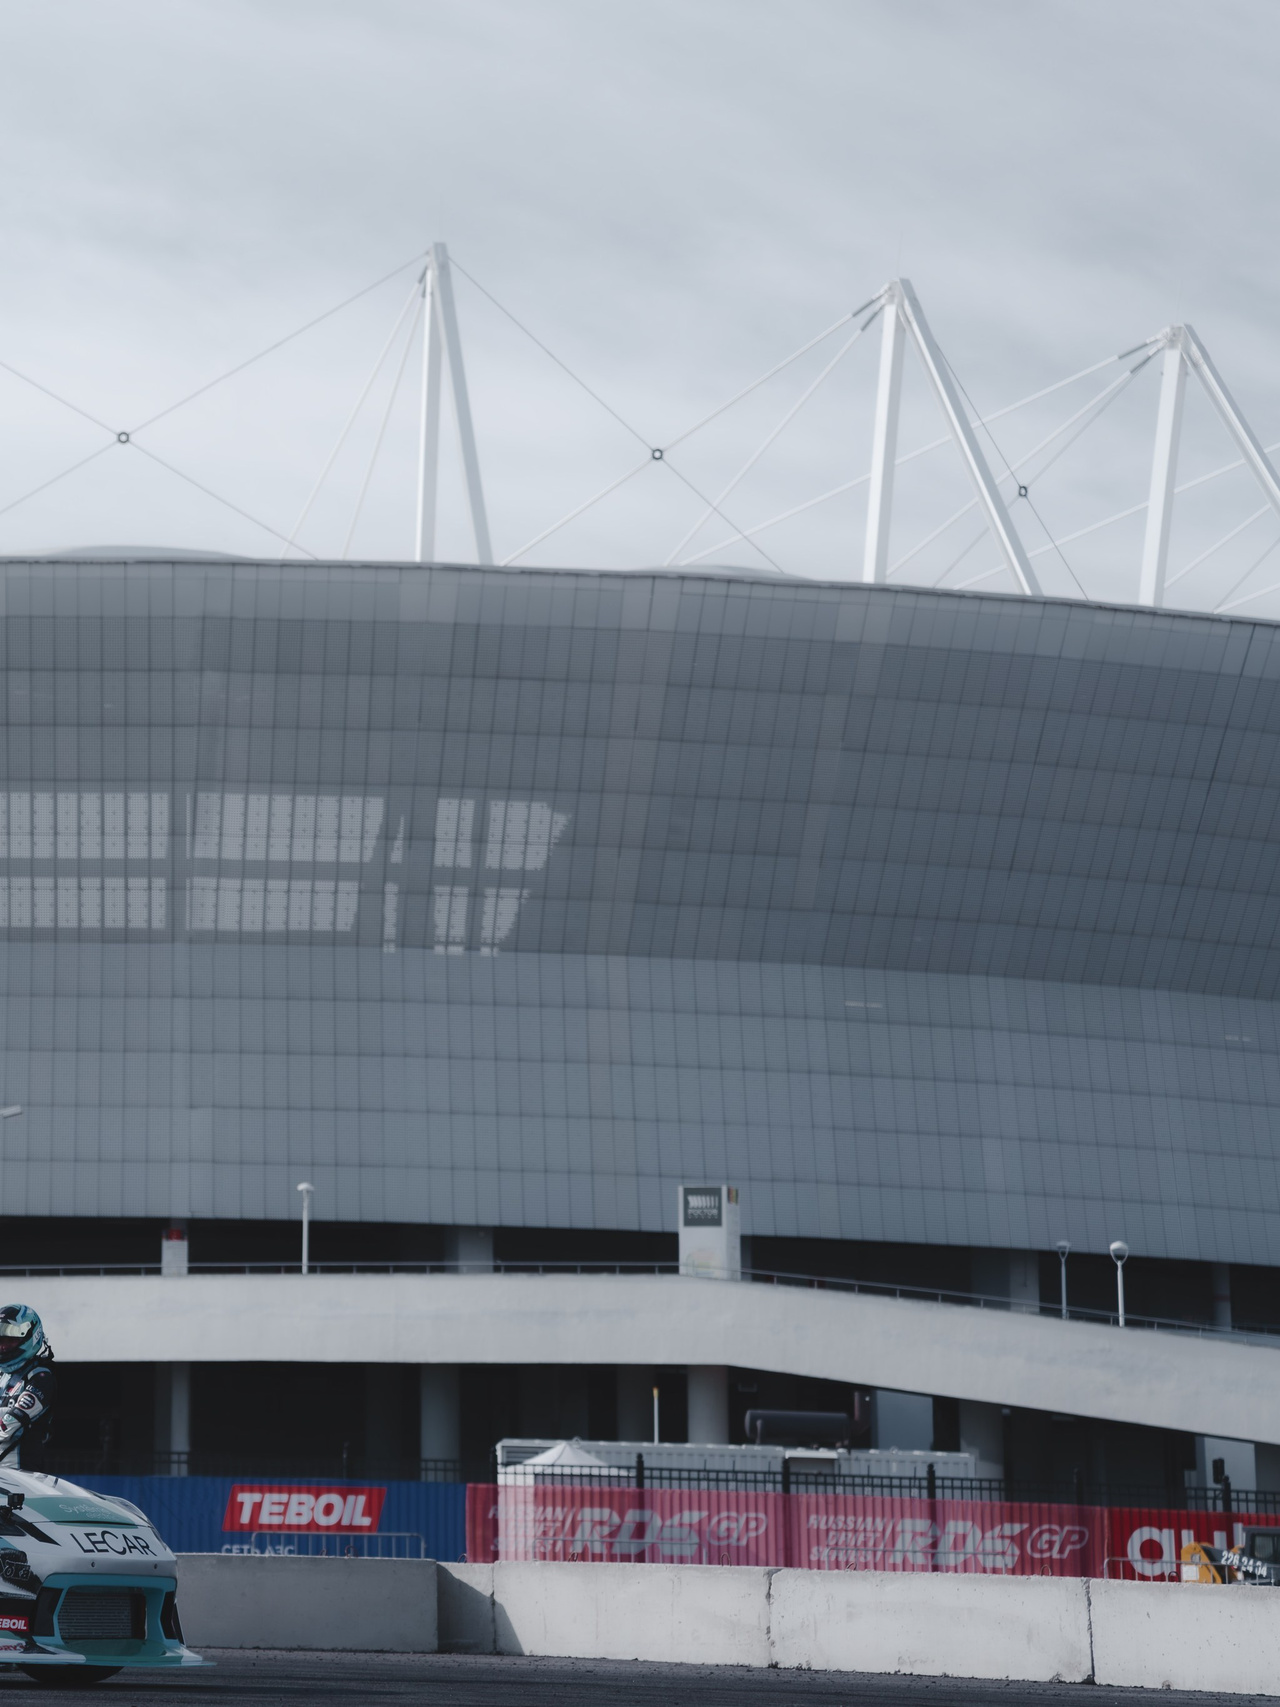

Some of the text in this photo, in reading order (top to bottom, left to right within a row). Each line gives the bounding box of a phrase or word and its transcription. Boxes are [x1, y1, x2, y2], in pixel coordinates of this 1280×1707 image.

[236, 1492, 373, 1526] TEBOIL
[808, 1514, 886, 1531] RUSSIAN
[70, 1530, 157, 1557] LECAR
[569, 1507, 768, 1556] RDS GP
[888, 1517, 1030, 1568] RDS
[1027, 1523, 1090, 1560] GP
